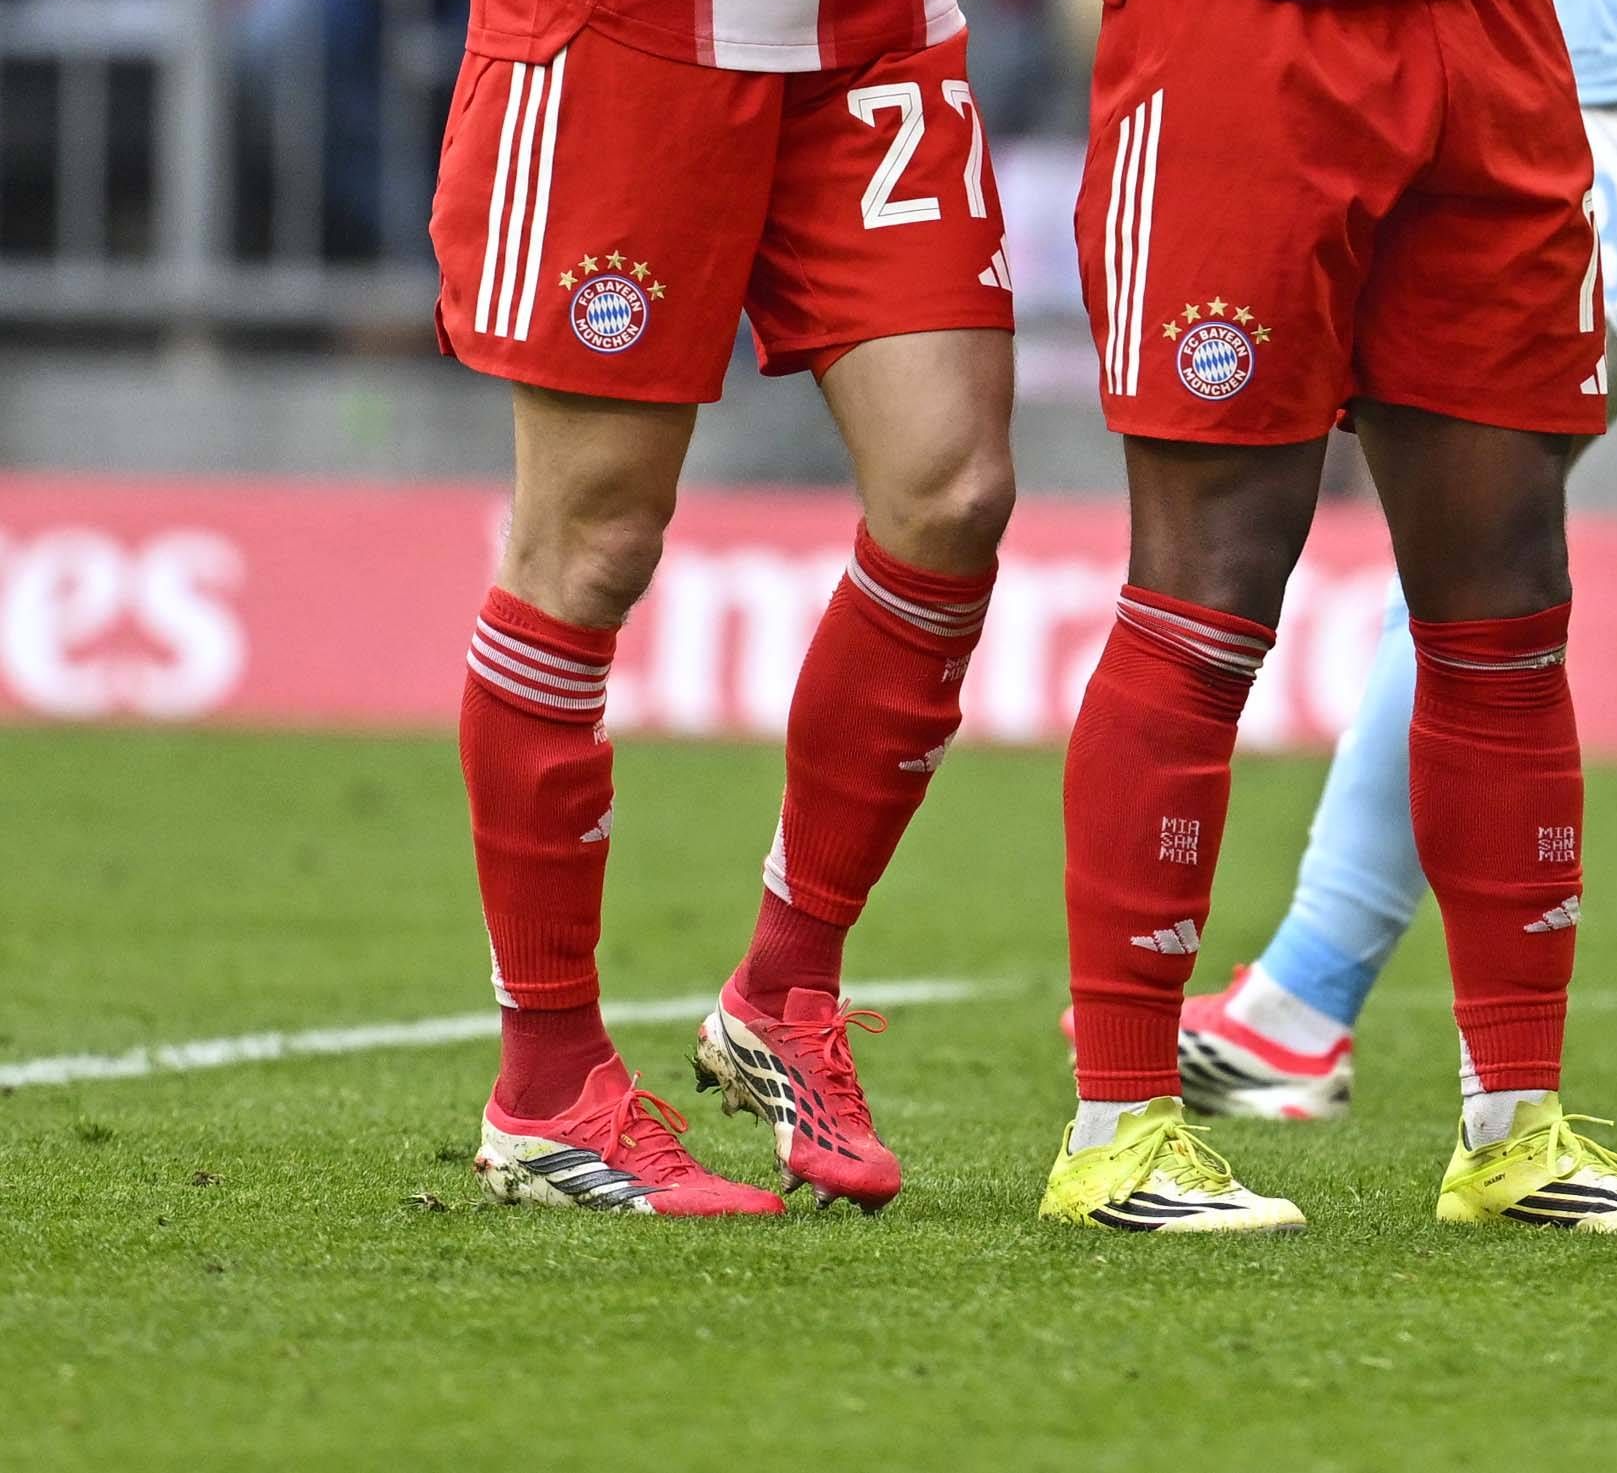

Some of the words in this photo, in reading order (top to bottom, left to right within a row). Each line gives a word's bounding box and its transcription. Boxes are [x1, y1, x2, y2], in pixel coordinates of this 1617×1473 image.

[578, 289, 595, 306] FC
[595, 281, 643, 313] BAYERN
[1183, 337, 1199, 356] FC
[1199, 327, 1249, 358] BAYERN
[1161, 816, 1200, 836] MIA
[1538, 826, 1574, 839] MIA
[1160, 832, 1198, 850] SAN
[1538, 838, 1574, 850] SAN
[1159, 845, 1198, 865] MIA
[1538, 850, 1575, 862] MIA
